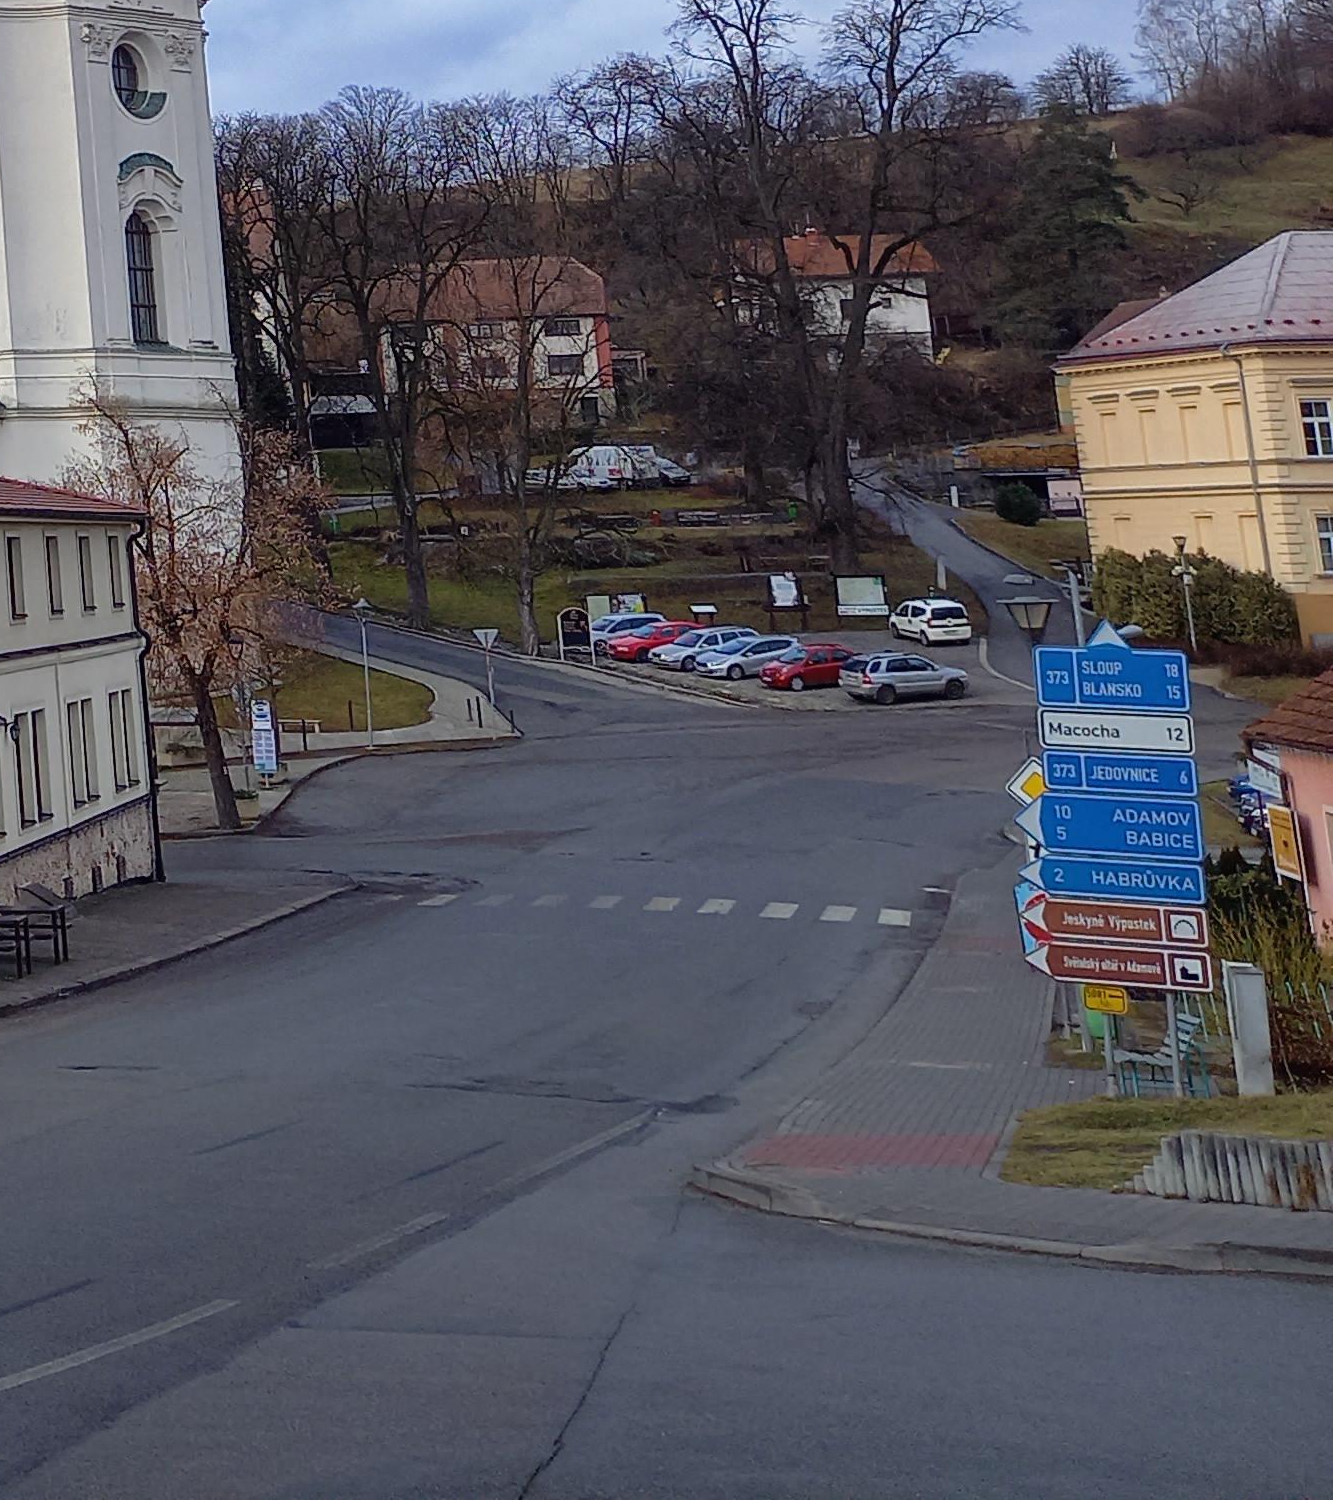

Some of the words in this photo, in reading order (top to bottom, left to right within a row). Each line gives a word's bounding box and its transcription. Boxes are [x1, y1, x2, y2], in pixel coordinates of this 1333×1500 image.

[1046, 670, 1070, 685] 373
[1081, 660, 1123, 676] SLOUP
[1164, 663, 1180, 678] 18
[1083, 681, 1142, 698] BLANSKO
[1166, 685, 1181, 700] 15
[1048, 721, 1121, 739] Macocha
[1165, 727, 1185, 742] 12
[1052, 763, 1077, 778] 373
[1090, 765, 1160, 783] JEDOVNICE
[1179, 770, 1189, 785] 6
[1053, 804, 1072, 820] 10
[1112, 808, 1191, 827] ADAMOV
[1056, 826, 1067, 841] 5
[1125, 830, 1195, 850] BABICE
[1053, 867, 1065, 883] 2
[1091, 869, 1197, 892] HABRŮVKA
